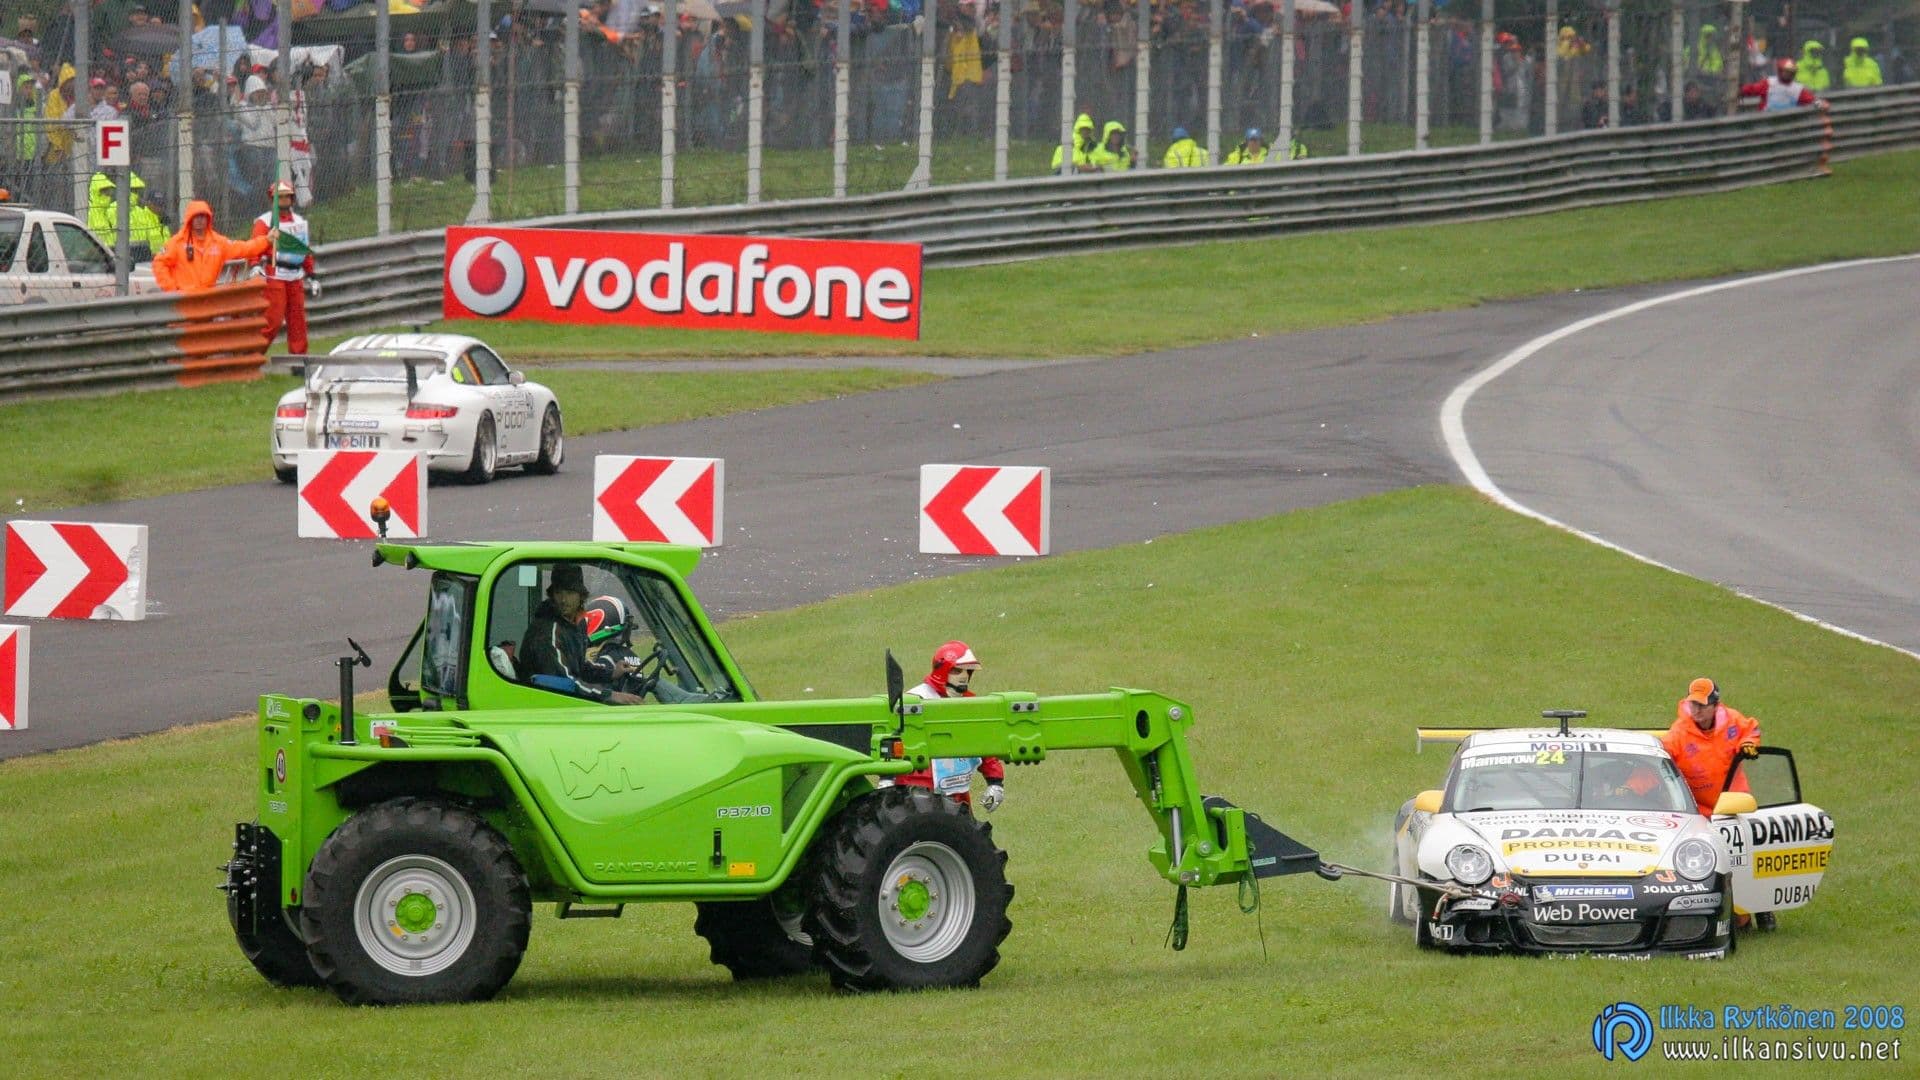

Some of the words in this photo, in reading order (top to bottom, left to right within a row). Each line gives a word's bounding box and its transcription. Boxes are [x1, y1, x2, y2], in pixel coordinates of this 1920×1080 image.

[102, 126, 123, 159] F
[535, 242, 911, 320] vodafone
[1531, 742, 1583, 752] Mobil
[1460, 754, 1536, 770] Mamerow
[1536, 751, 1565, 765] 24
[717, 805, 772, 818] P37.10
[1501, 828, 1658, 842] DAMAC
[1749, 811, 1834, 846] DAMAC
[1508, 840, 1653, 853] PROPERTIES
[1544, 853, 1621, 864] DUBAI
[594, 861, 697, 873] PANORAMIC
[1554, 887, 1629, 896] MICHELIN
[1643, 884, 1709, 894] JOALPE.NL
[1533, 907, 1573, 921] Web
[1578, 903, 1637, 920] Power
